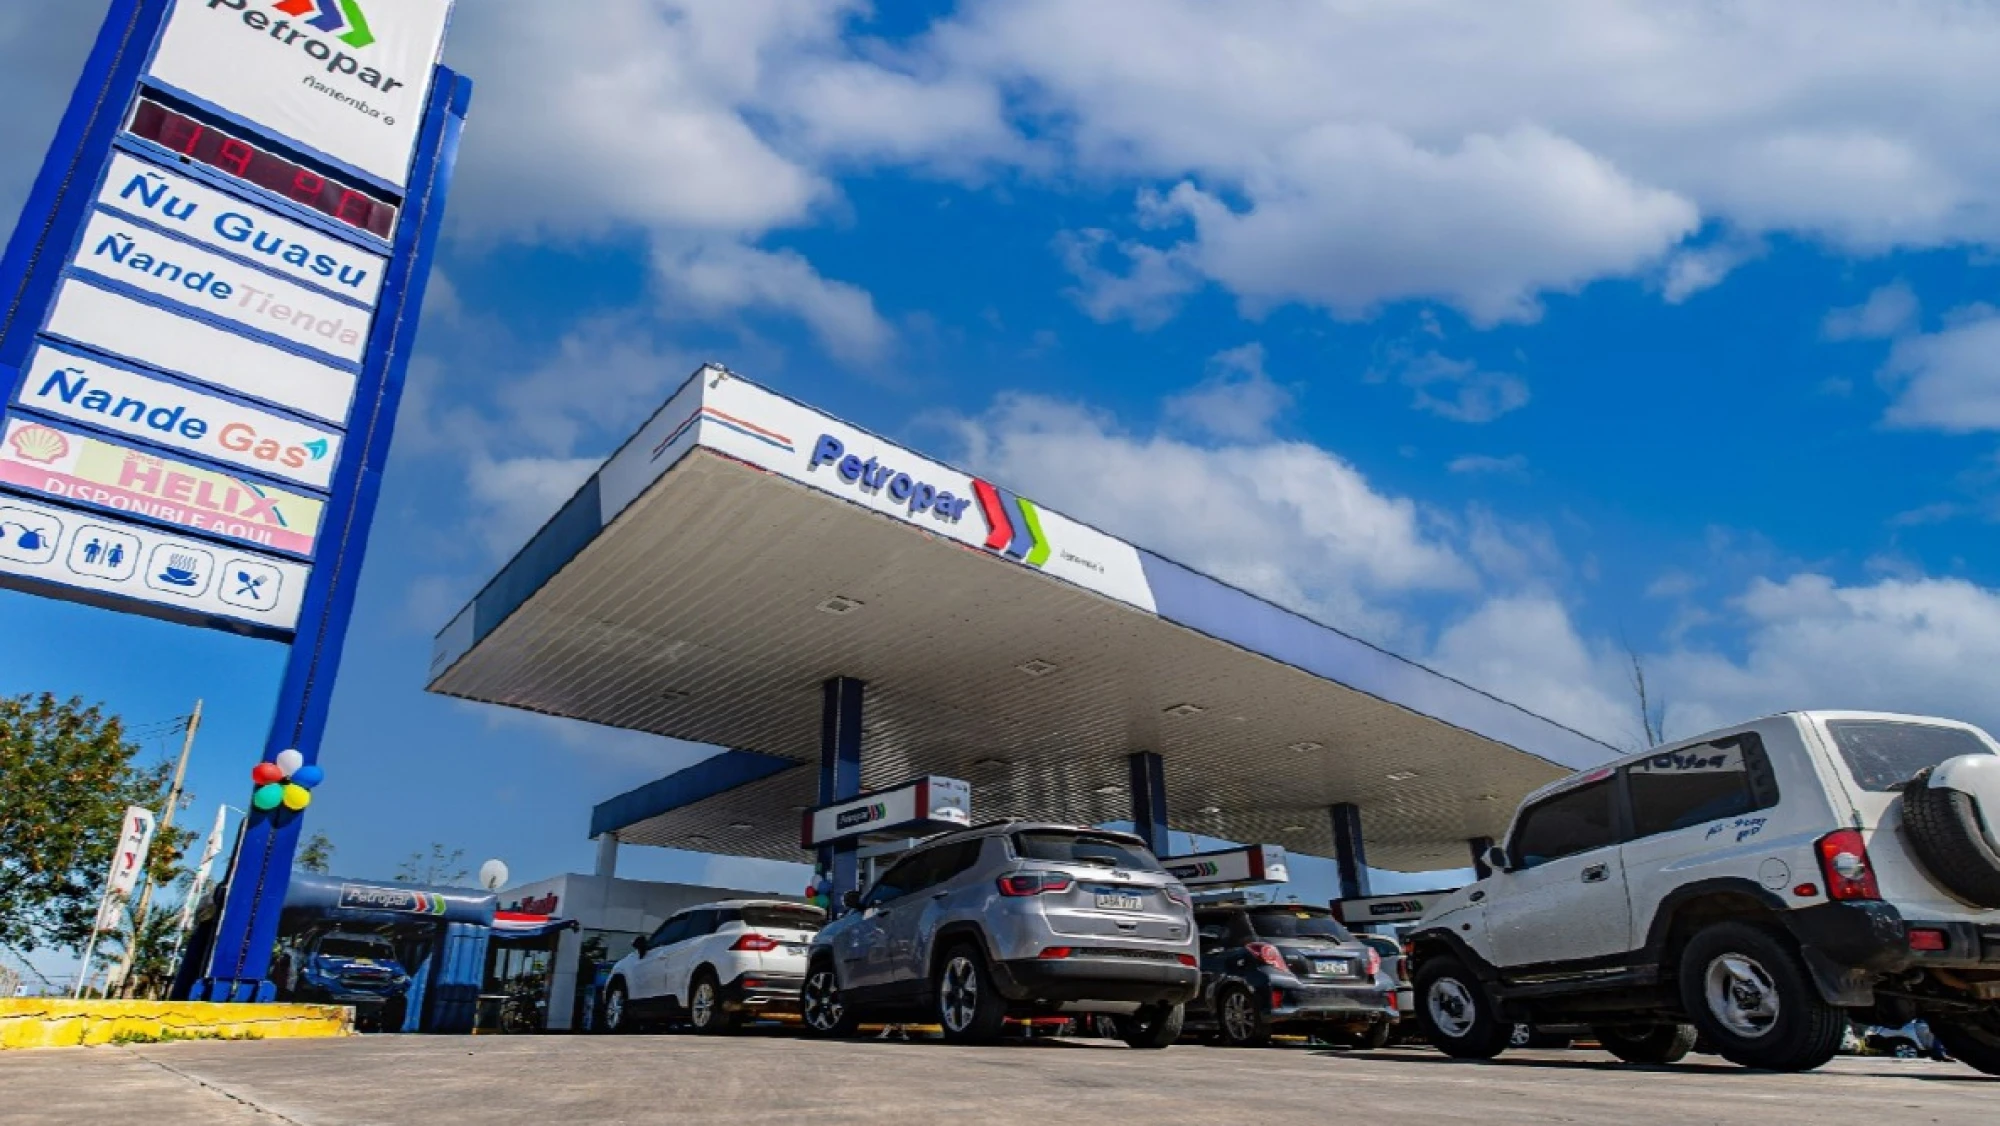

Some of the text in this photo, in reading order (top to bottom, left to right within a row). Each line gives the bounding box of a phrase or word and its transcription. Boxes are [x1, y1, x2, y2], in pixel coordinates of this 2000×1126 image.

[120, 171, 367, 288] Ñu Guasu
[38, 367, 308, 469] Ñande Gas
[118, 460, 281, 526] HELIX
[808, 433, 972, 523] Petropar
